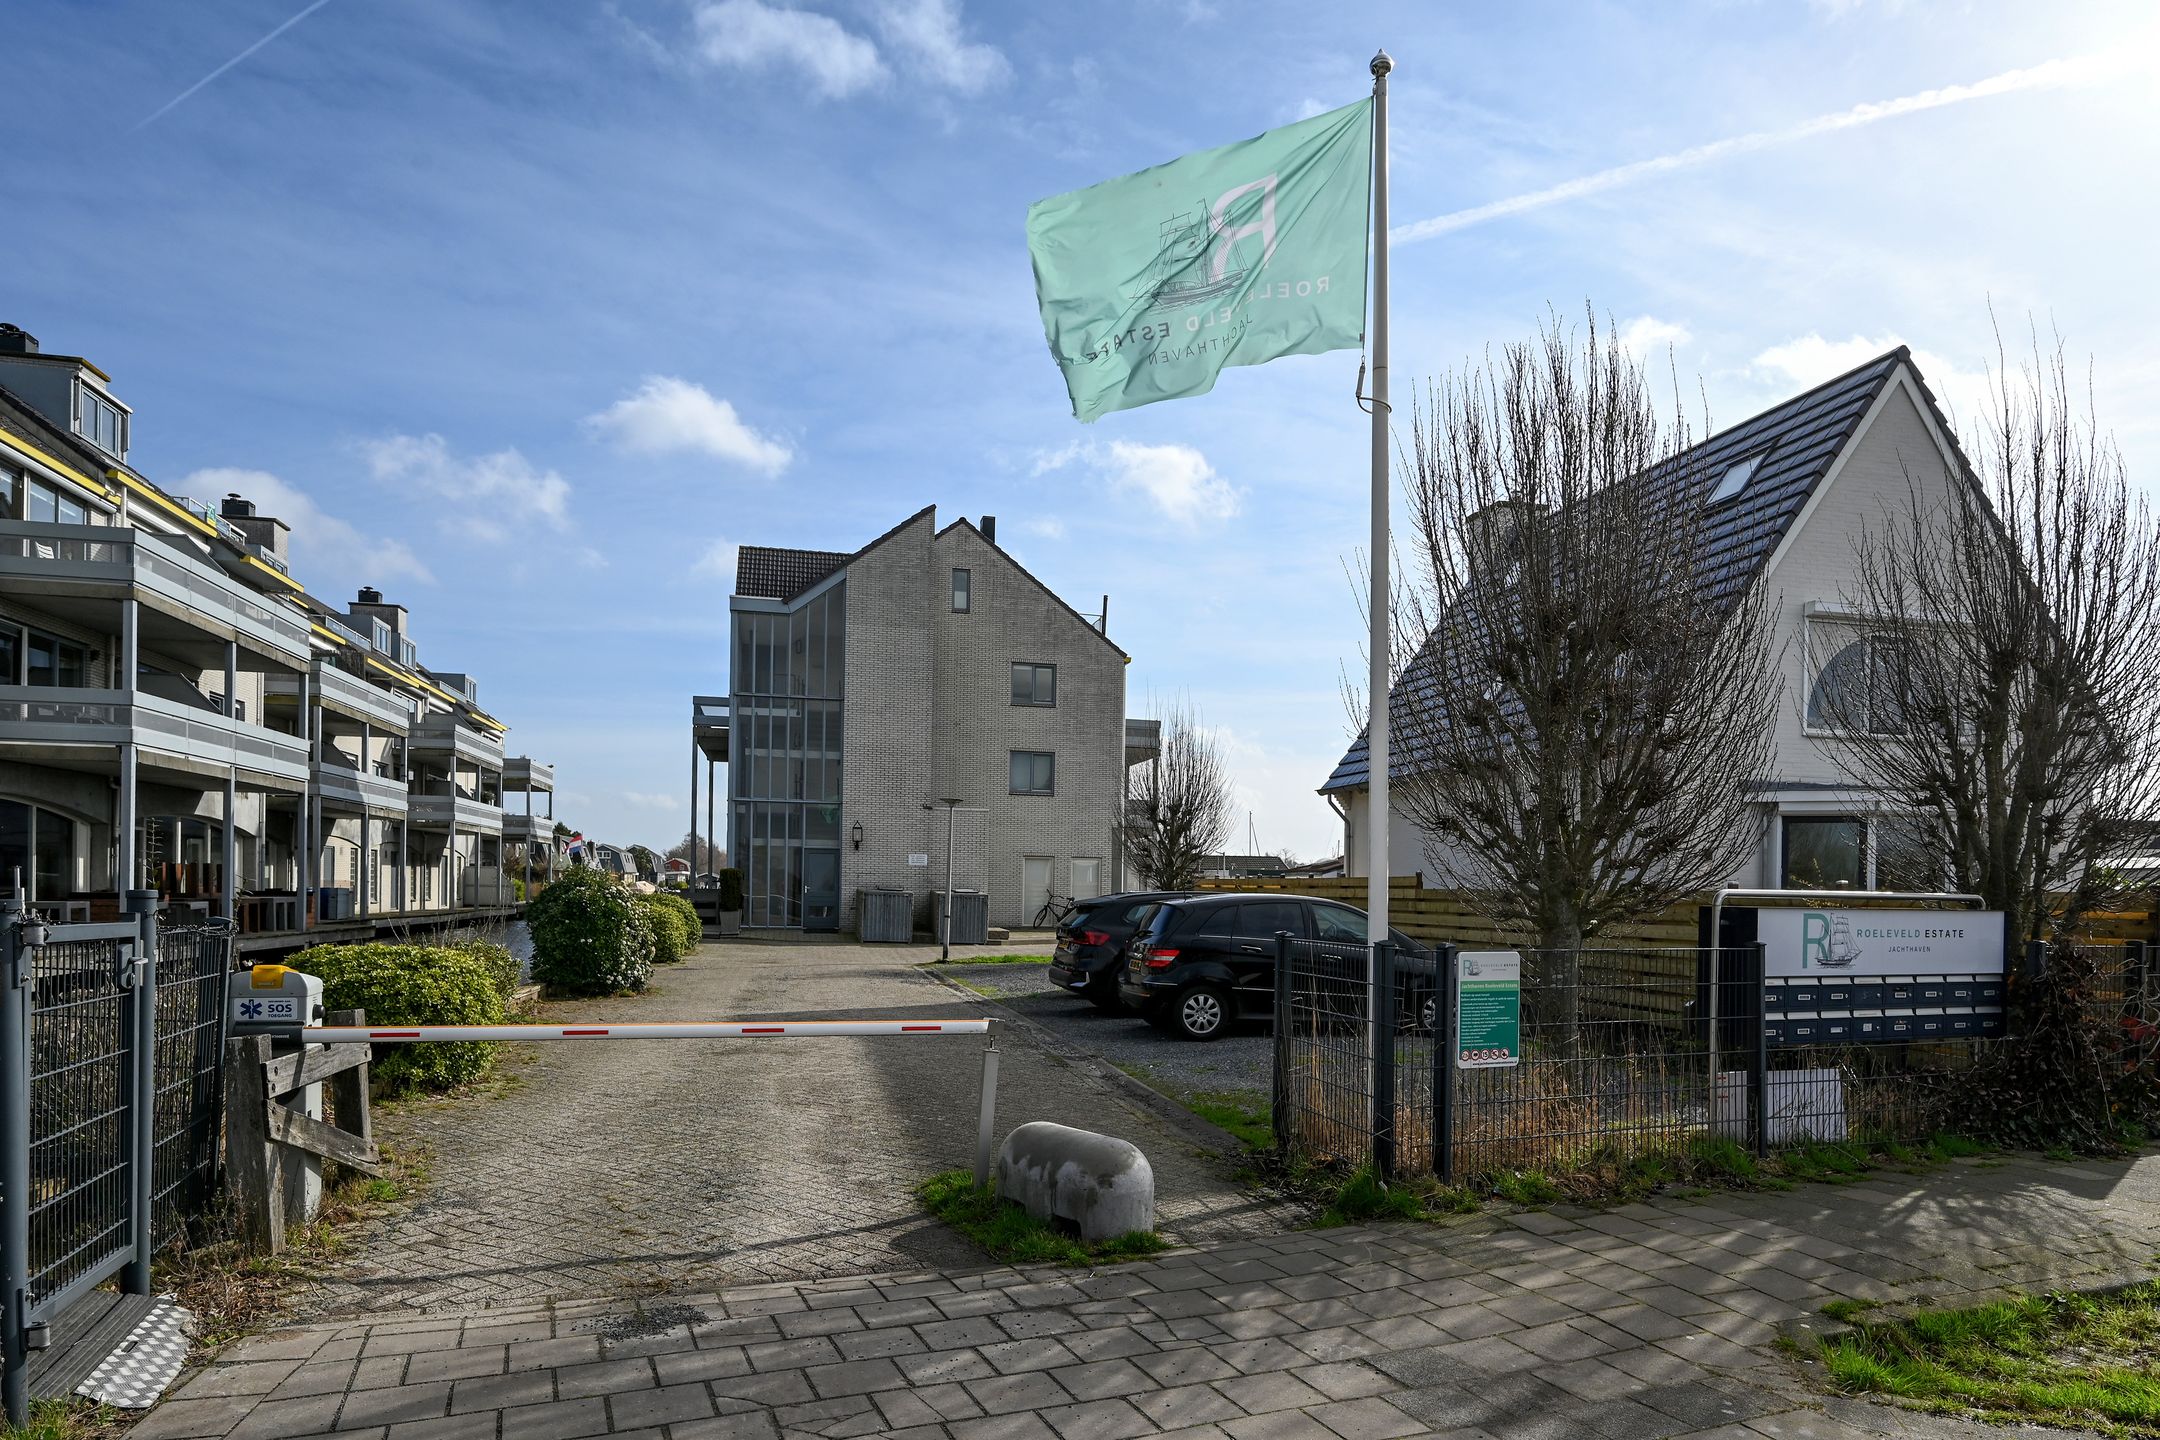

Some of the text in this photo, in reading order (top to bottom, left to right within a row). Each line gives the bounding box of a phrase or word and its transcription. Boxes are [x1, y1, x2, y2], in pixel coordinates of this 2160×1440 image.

[1856, 928, 1965, 939] ROELEVELD ESTATE
[1888, 945, 1931, 953] JACHTHAVEN
[268, 1004, 292, 1013] SOS
